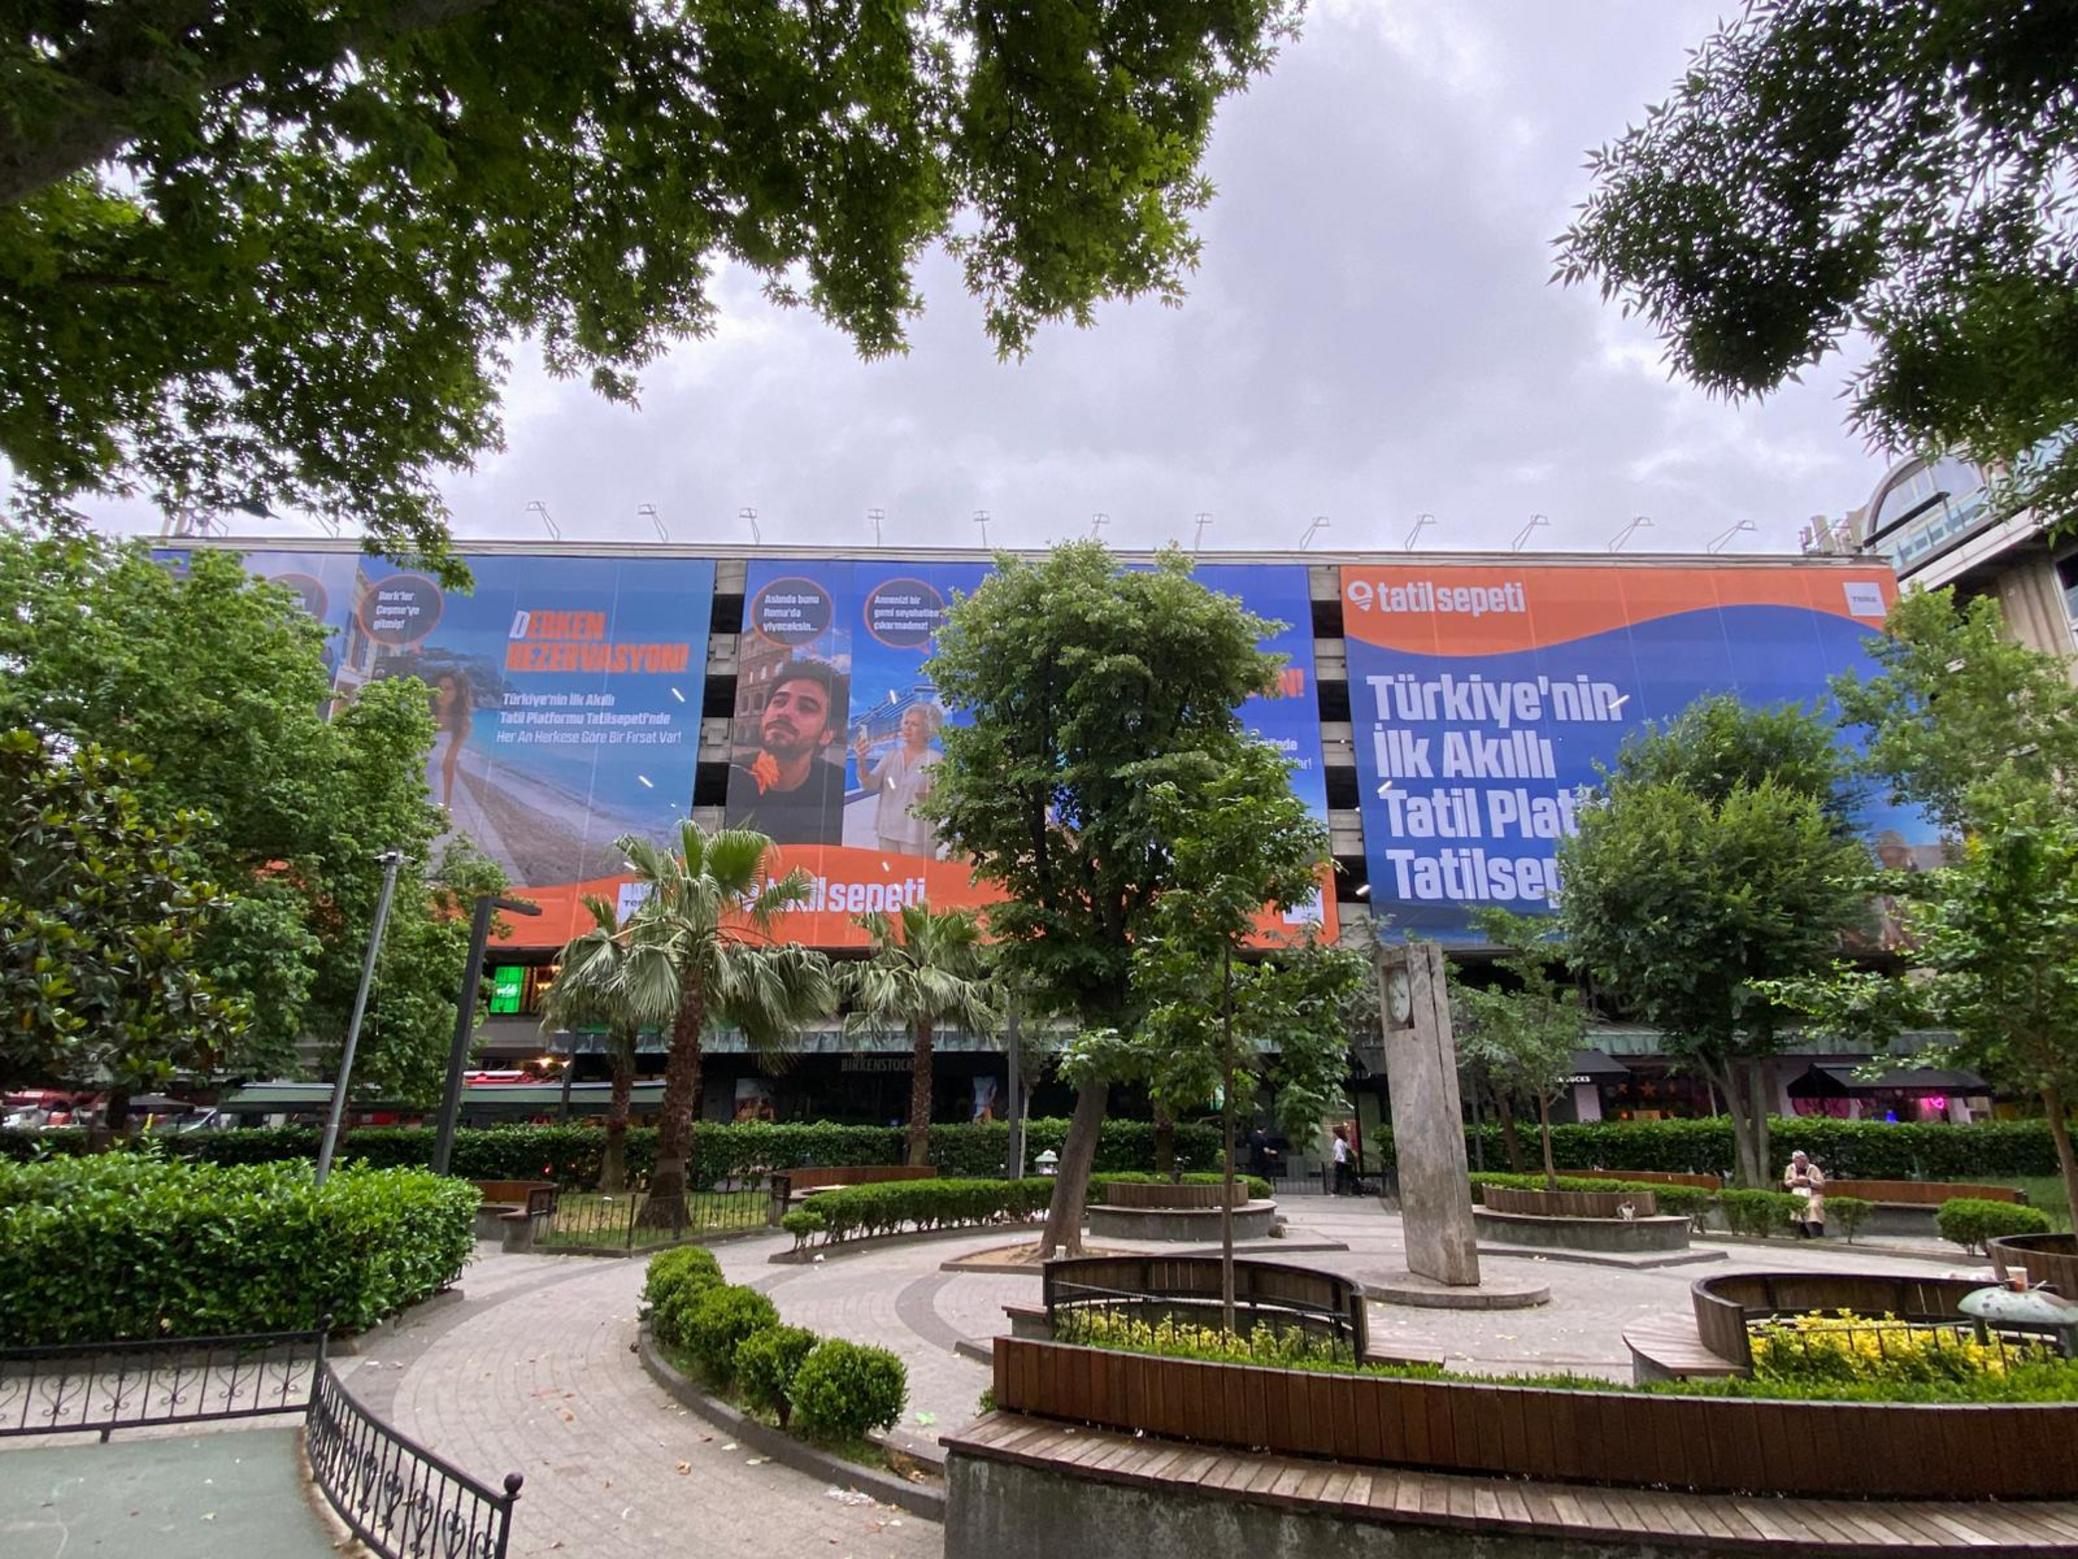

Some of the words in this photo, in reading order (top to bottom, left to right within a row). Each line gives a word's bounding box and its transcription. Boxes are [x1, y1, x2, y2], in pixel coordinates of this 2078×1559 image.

[763, 608, 802, 618] Roma'da
[506, 642, 690, 674] REZERVASYON!
[503, 692, 567, 708] Türkiye'nin
[1366, 673, 1623, 729] Türkiye'nin
[500, 711, 526, 725] Tatil
[526, 711, 584, 725] Platformu
[585, 711, 672, 727] Tatilsepeti'nde
[496, 730, 517, 744] Her
[517, 730, 533, 744] An
[534, 730, 580, 744] Herkese
[581, 730, 607, 745] Göre
[609, 730, 625, 744] Bir
[626, 730, 657, 744] Fırsat
[659, 730, 683, 744] Var!
[1373, 722, 1434, 778] İlk
[1442, 730, 1557, 779] Akıllı
[1379, 787, 1482, 838] Tatil
[1486, 787, 1581, 838] Plat
[1386, 847, 1560, 910] Tatilsep
